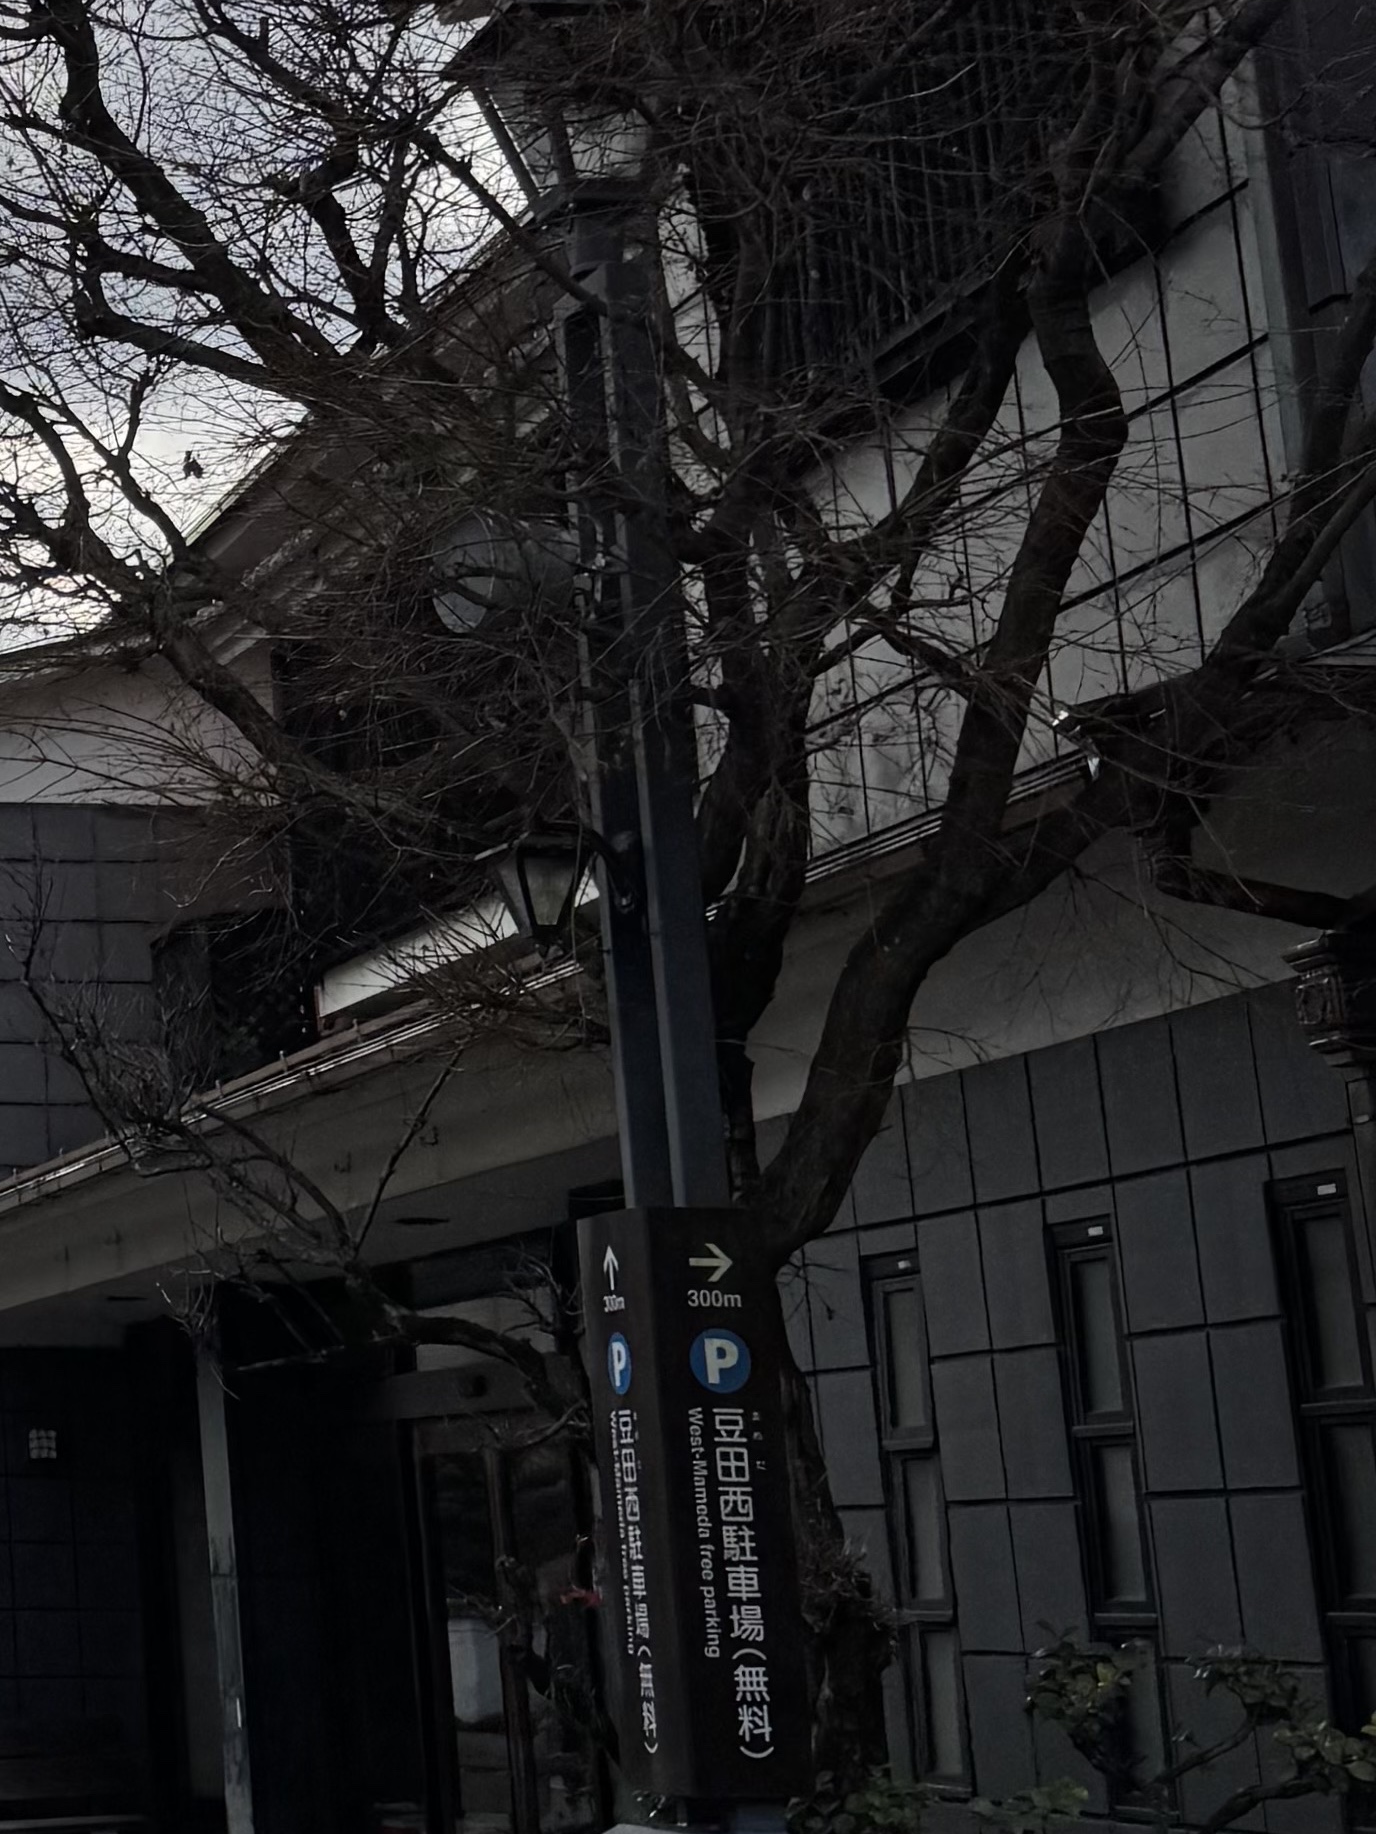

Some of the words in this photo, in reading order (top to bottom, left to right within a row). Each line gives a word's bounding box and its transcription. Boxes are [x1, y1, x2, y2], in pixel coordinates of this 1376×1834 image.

[687, 1289, 743, 1308] 300m
[611, 1341, 626, 1387] P
[704, 1338, 739, 1384] P
[699, 1544, 715, 1581] free
[700, 1585, 722, 1658] parking
